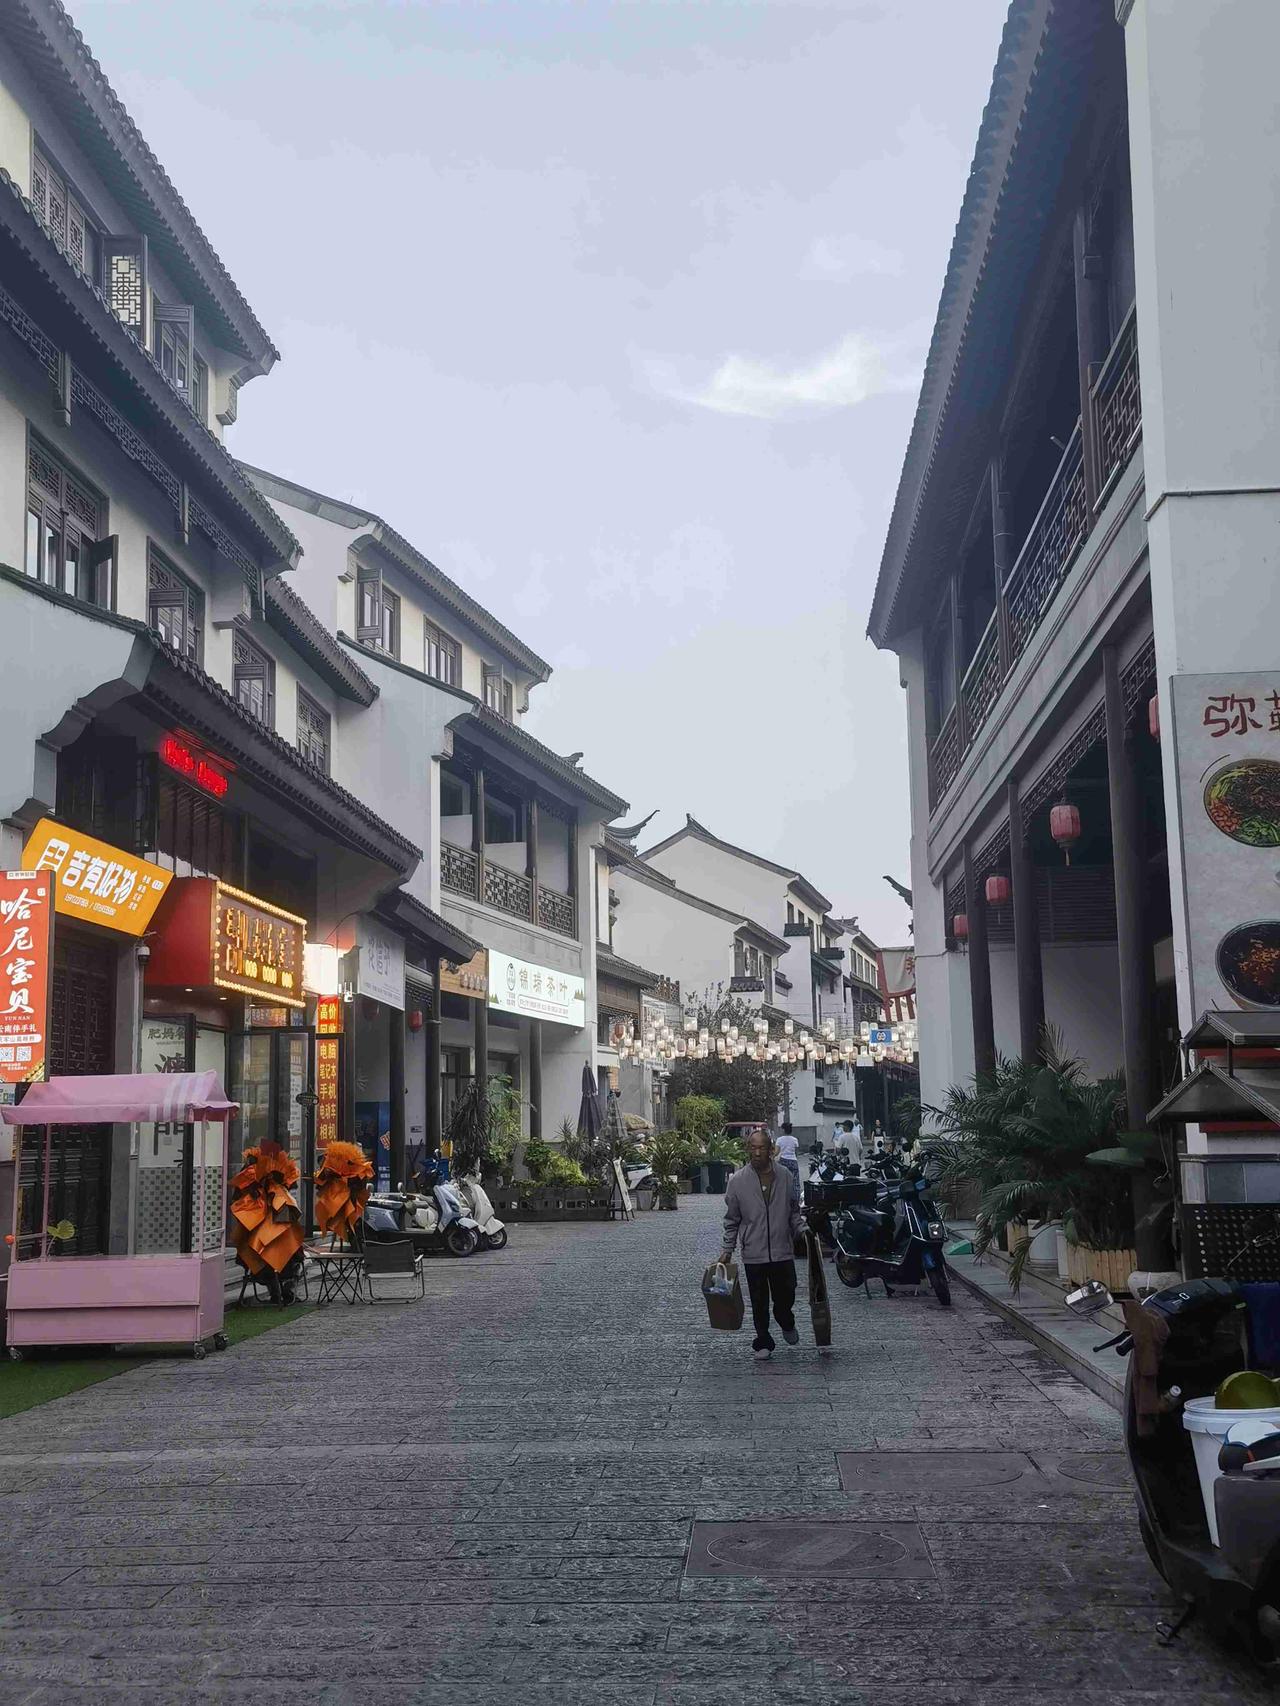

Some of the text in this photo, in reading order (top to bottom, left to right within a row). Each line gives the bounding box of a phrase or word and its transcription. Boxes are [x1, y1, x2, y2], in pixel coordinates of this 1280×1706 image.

[1203, 689, 1280, 738] 弥
[0, 887, 42, 1013] 哈尼宝贝
[319, 1003, 337, 1020] 高价
[319, 1043, 337, 1059] 电脑
[319, 1063, 337, 1080] 笔记本
[319, 1083, 337, 1100] 手机
[319, 1103, 337, 1120] 电动车
[319, 1123, 337, 1141] 相机
